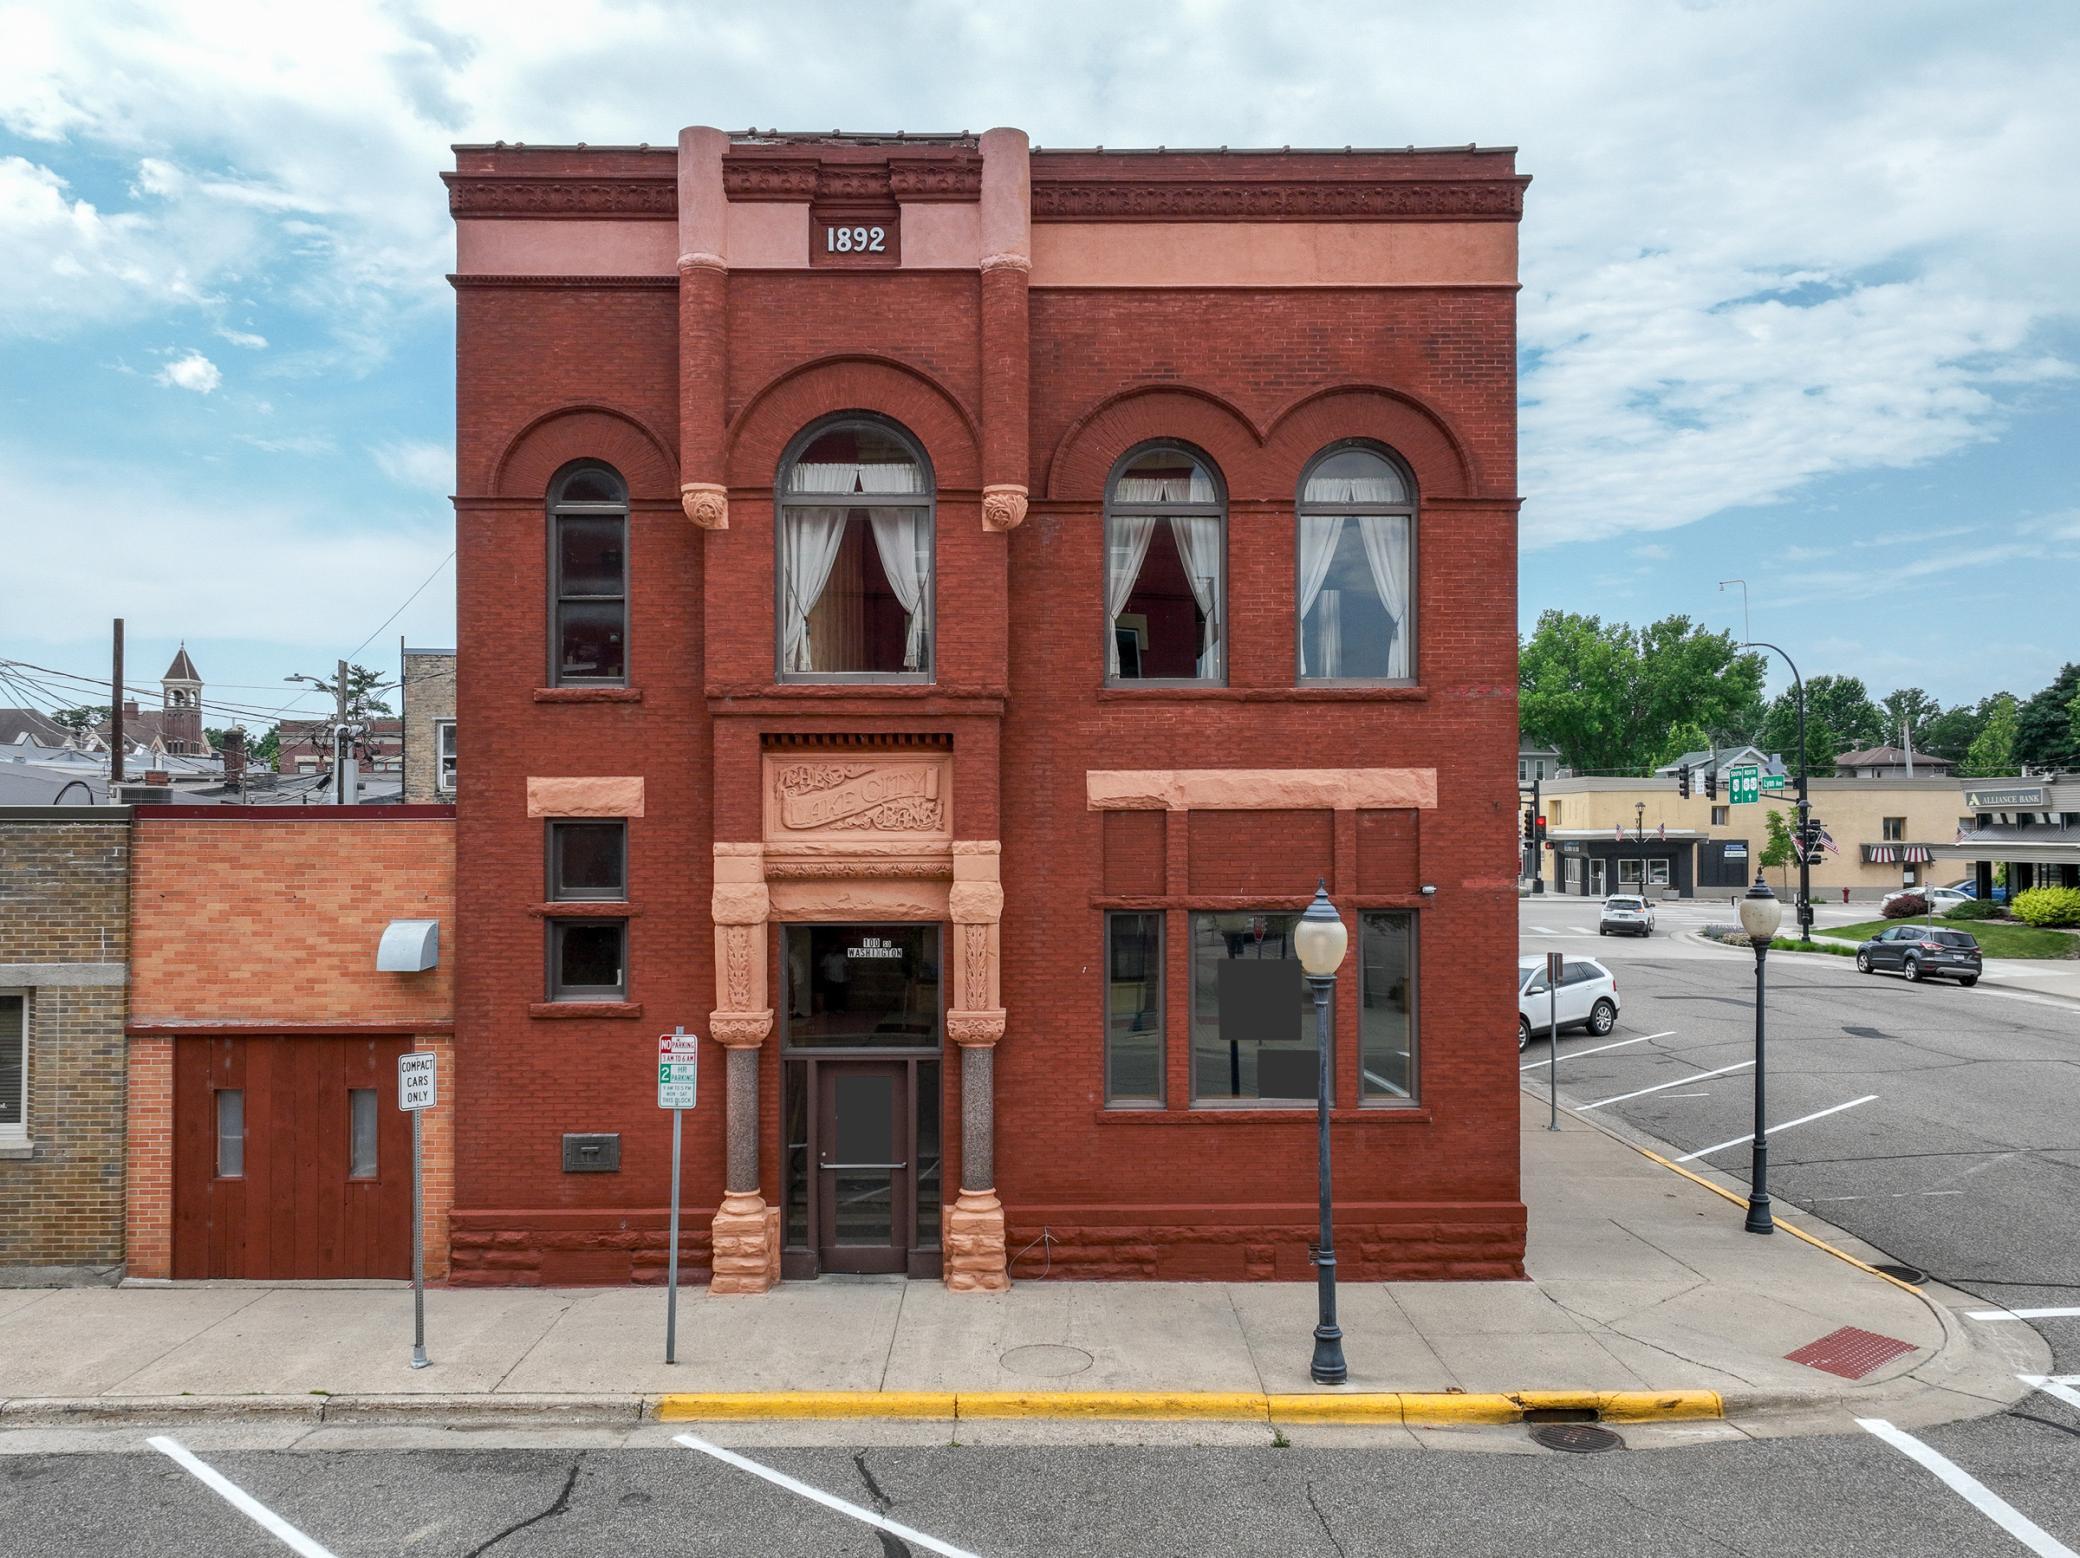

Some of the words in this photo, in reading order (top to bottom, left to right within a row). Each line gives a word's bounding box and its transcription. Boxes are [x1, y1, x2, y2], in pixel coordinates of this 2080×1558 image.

[828, 226, 885, 252] 1892
[789, 792, 856, 826] LAKE
[861, 772, 926, 802] CITY
[1982, 796, 2017, 804] ALLIANCE
[2019, 794, 2040, 803] BANK
[864, 938, 880, 948] 100
[848, 948, 902, 957] WASHINGTON
[661, 1039, 671, 1050] NO
[671, 1041, 695, 1049] PARKING
[401, 1059, 433, 1073] COMPACT
[661, 1067, 670, 1081] 2
[407, 1075, 428, 1087] CARS
[407, 1091, 428, 1102] ONLY
